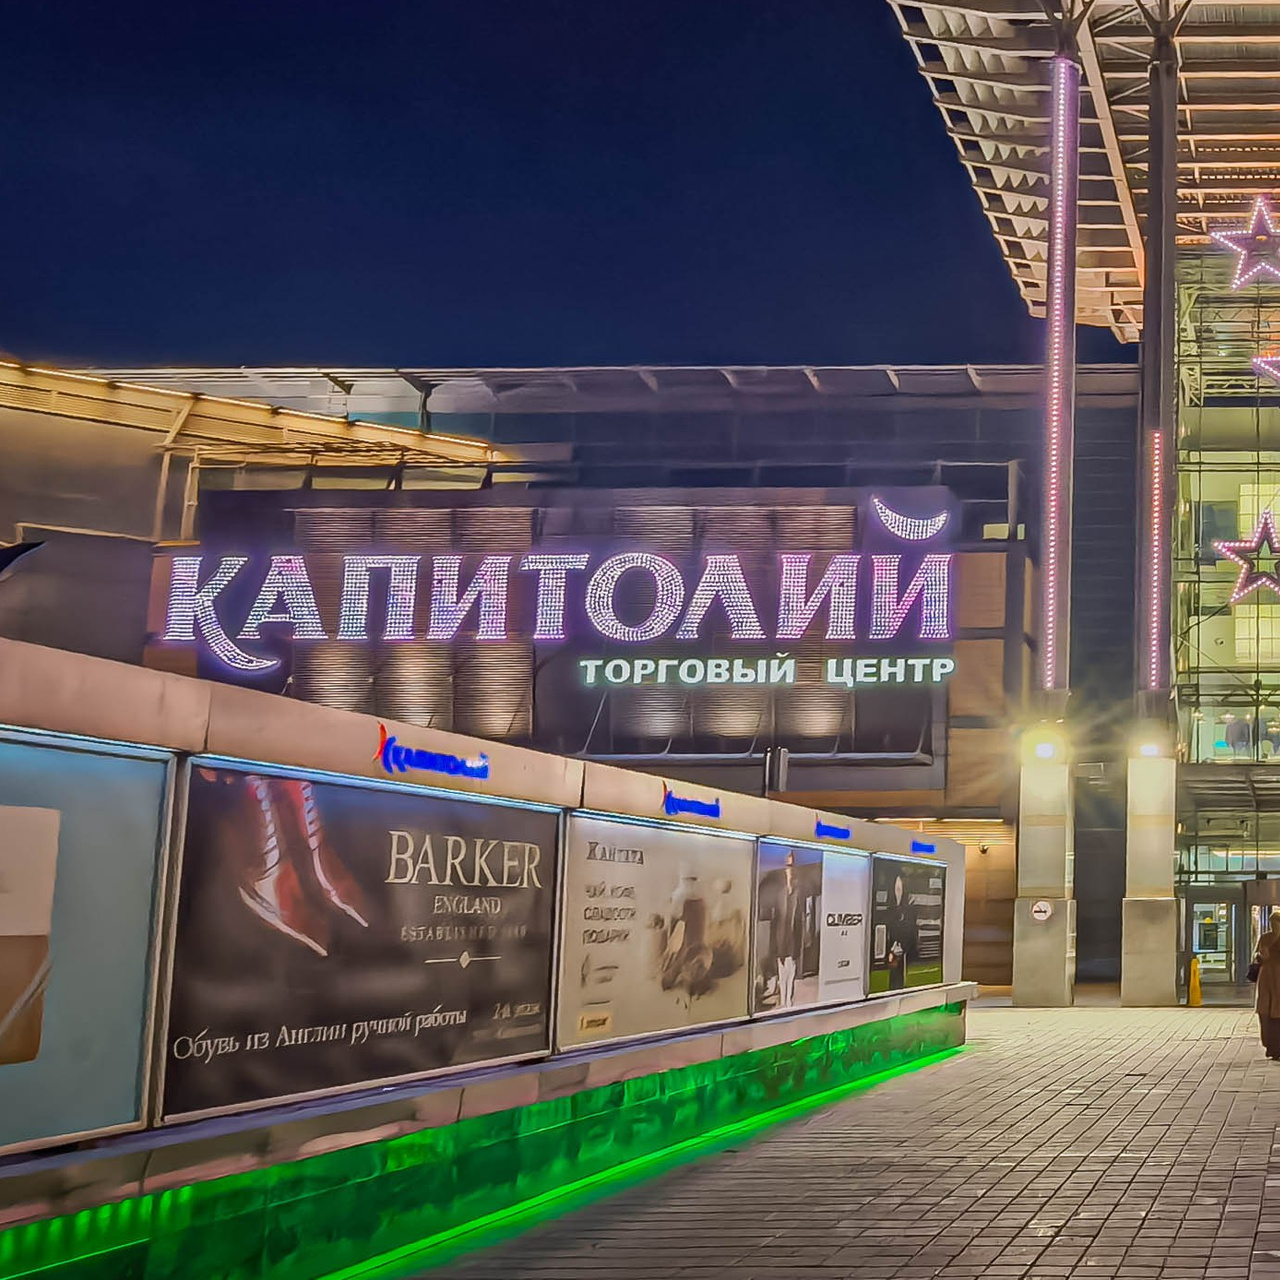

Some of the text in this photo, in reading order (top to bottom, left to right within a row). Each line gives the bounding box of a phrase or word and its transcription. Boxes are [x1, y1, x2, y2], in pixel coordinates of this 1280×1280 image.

[161, 496, 955, 671] КАПИТОЛИЙ
[580, 652, 956, 688] ТОРГОВЫЙ ЦЕНТР
[384, 830, 542, 889] BARKER
[433, 895, 502, 915] ENGLAND
[173, 1025, 240, 1065] Обувь
[245, 1031, 270, 1051] из
[275, 1023, 348, 1048] Англии
[350, 1010, 413, 1046] ручной
[414, 1003, 467, 1038] работы
